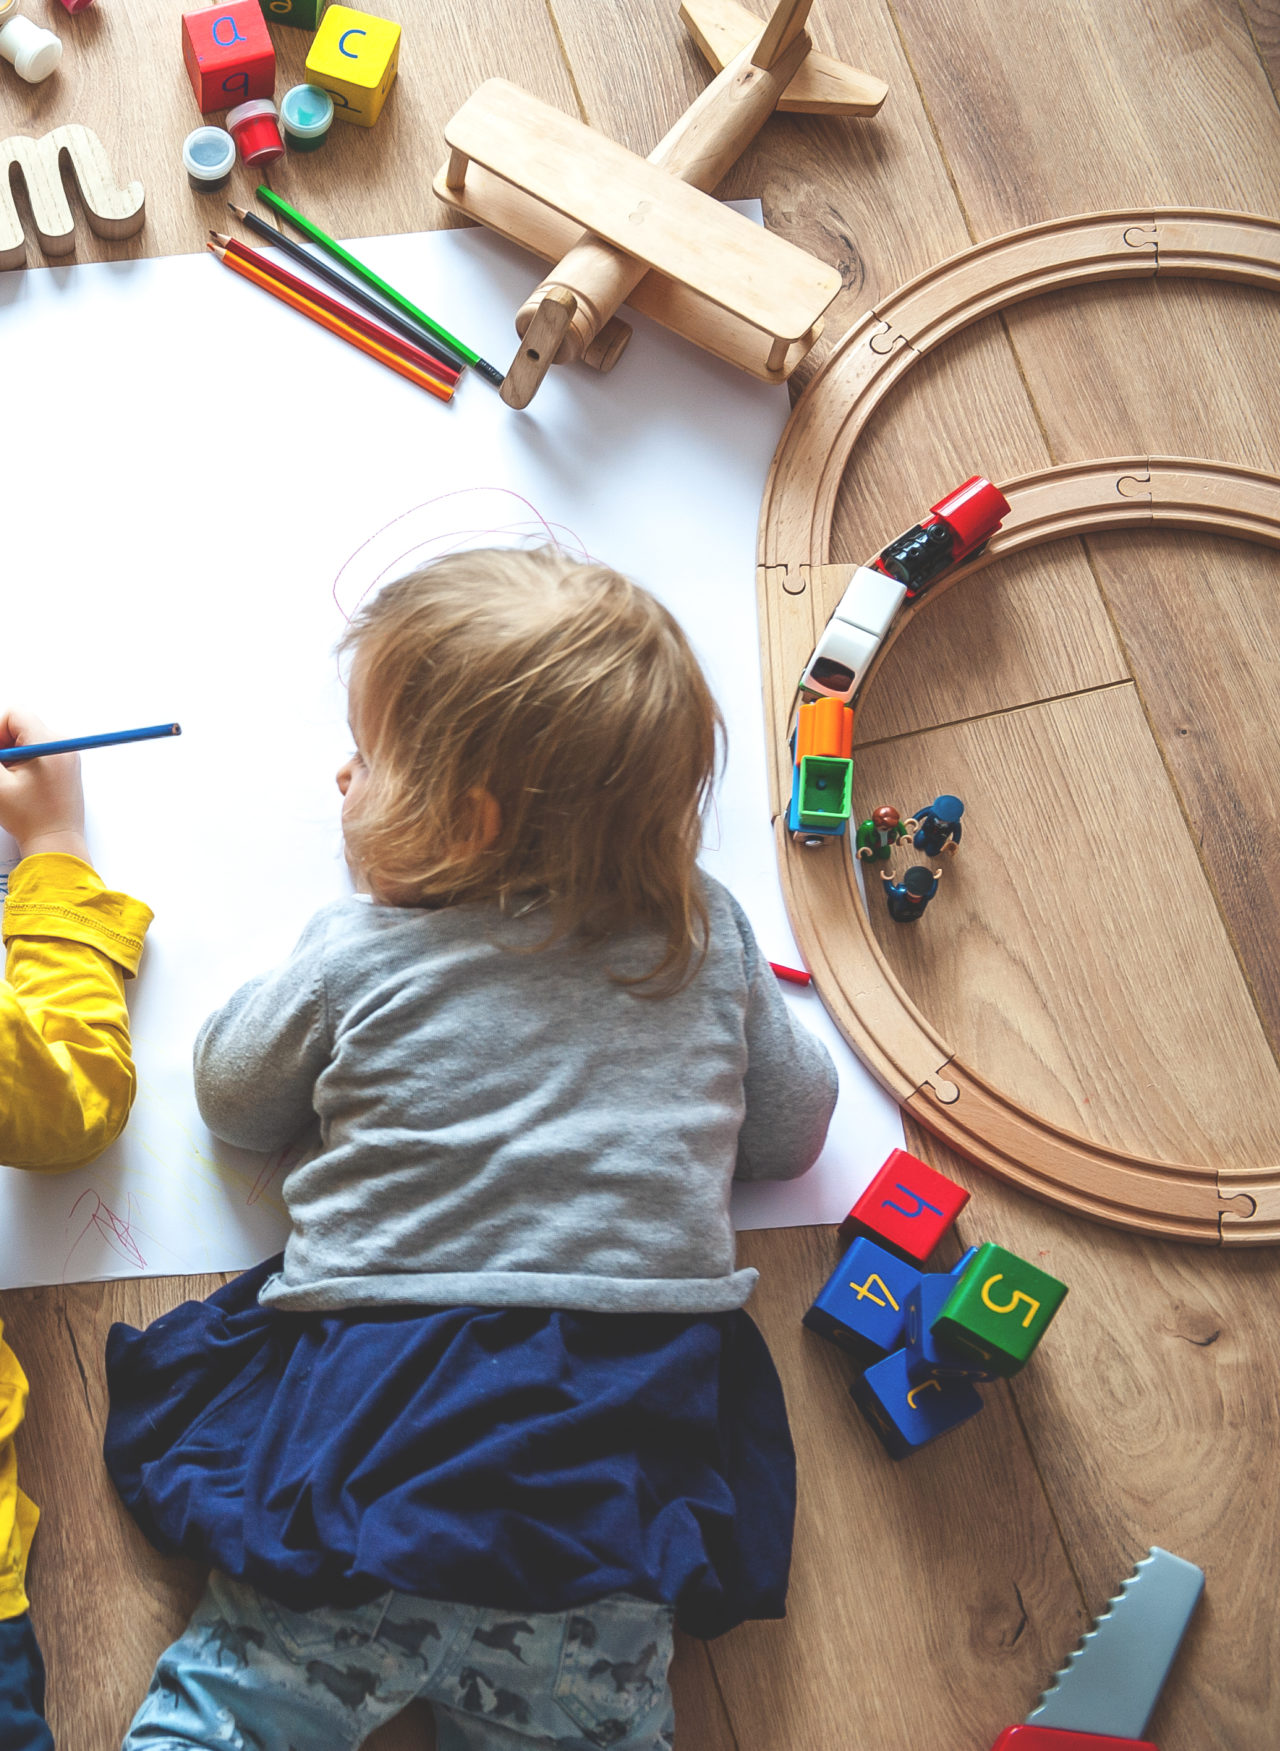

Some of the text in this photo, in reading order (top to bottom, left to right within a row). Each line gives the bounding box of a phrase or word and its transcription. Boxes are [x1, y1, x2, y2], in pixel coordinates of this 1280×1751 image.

[212, 16, 247, 47] a
[849, 1274, 900, 1312] 4
[981, 1273, 1041, 1328] 5
